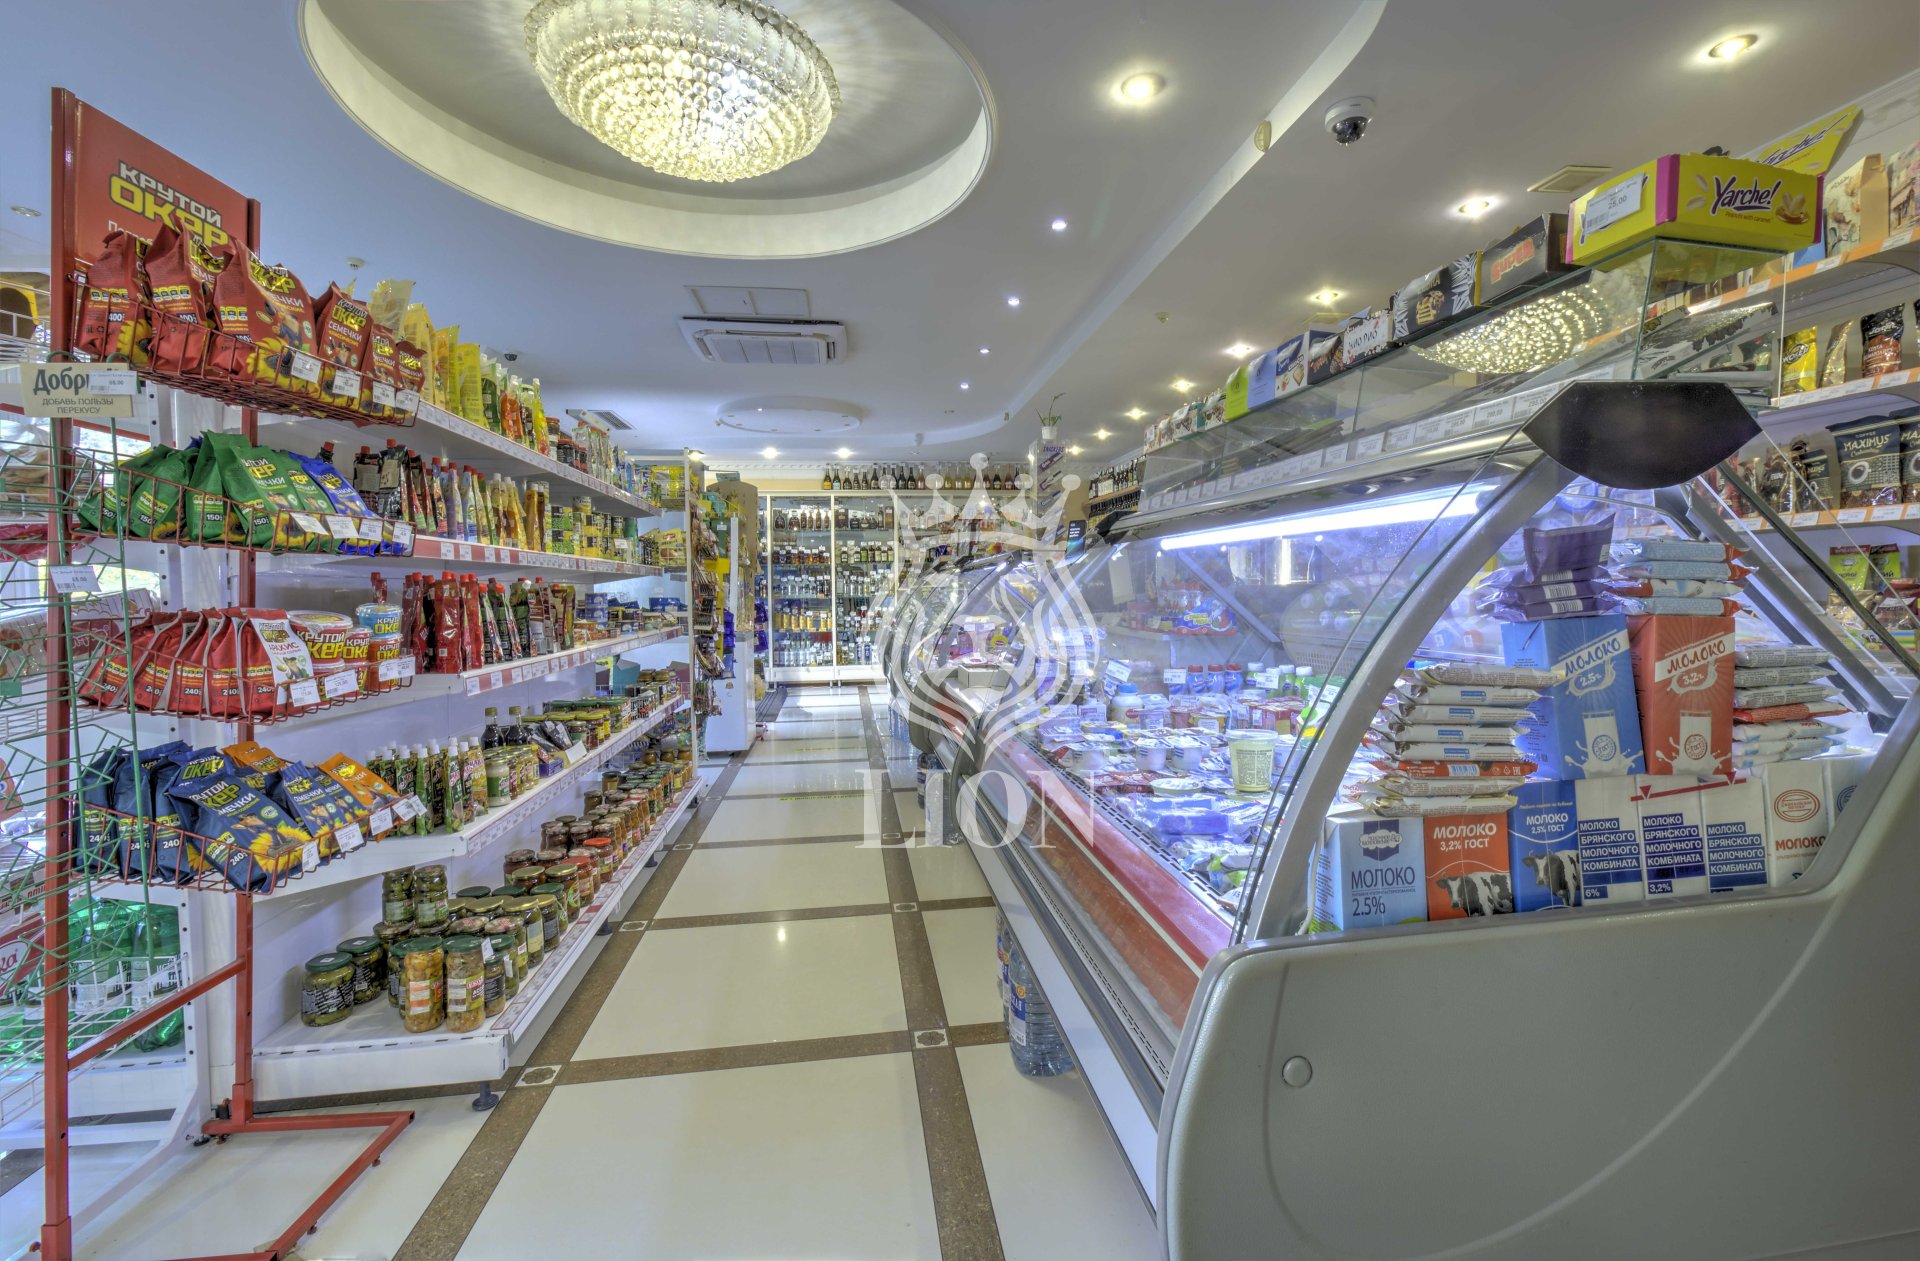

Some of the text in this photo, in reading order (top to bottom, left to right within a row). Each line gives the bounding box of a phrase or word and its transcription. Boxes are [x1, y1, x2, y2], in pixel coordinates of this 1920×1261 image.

[119, 161, 223, 228] КРУТОЙ
[1711, 175, 1782, 214] Yarche!
[328, 320, 362, 342] СЕМЕЧКИ
[43, 398, 113, 406] ДОБАВЬ ПОЛЬЗЫ
[1844, 434, 1890, 452] MAXIMUS
[207, 513, 221, 521] 150
[254, 518, 267, 526] 150
[1565, 638, 1621, 674] МОЛОКО
[1668, 640, 1726, 674] МОЛОКО
[1526, 813, 1568, 825] МОЛОКО
[1644, 816, 1682, 827] МОЛОКО
[1434, 822, 1497, 839] МОЛОКО
[1548, 824, 1564, 832] ГОСТ
[1580, 820, 1618, 831] МОЛОКО
[1708, 824, 1744, 835] МОЛОКО
[1581, 832, 1635, 844] БРЯНСКОГО
[1645, 827, 1698, 840] БРЯНСКОГО
[163, 840, 179, 848] 240
[1440, 838, 1489, 851] 3,2% ГОСТ
[1646, 840, 1702, 853] МОЛОЧНОГО
[1709, 836, 1760, 848] БРЯНСКОГО
[1582, 845, 1638, 857] МОЛОЧНОГО
[1710, 849, 1764, 861] МОЛОЧНОГО
[230, 851, 244, 866] 240
[1648, 854, 1702, 866] КОМБИНАТА
[1583, 859, 1638, 871] КОМБИНАТА
[1711, 862, 1763, 873] КОМБИНАТА
[1351, 866, 1415, 890] МОЛОКО
[1586, 888, 1600, 897] 6%
[1650, 884, 1671, 893] 3,2%
[1353, 895, 1386, 917] 2.5%
